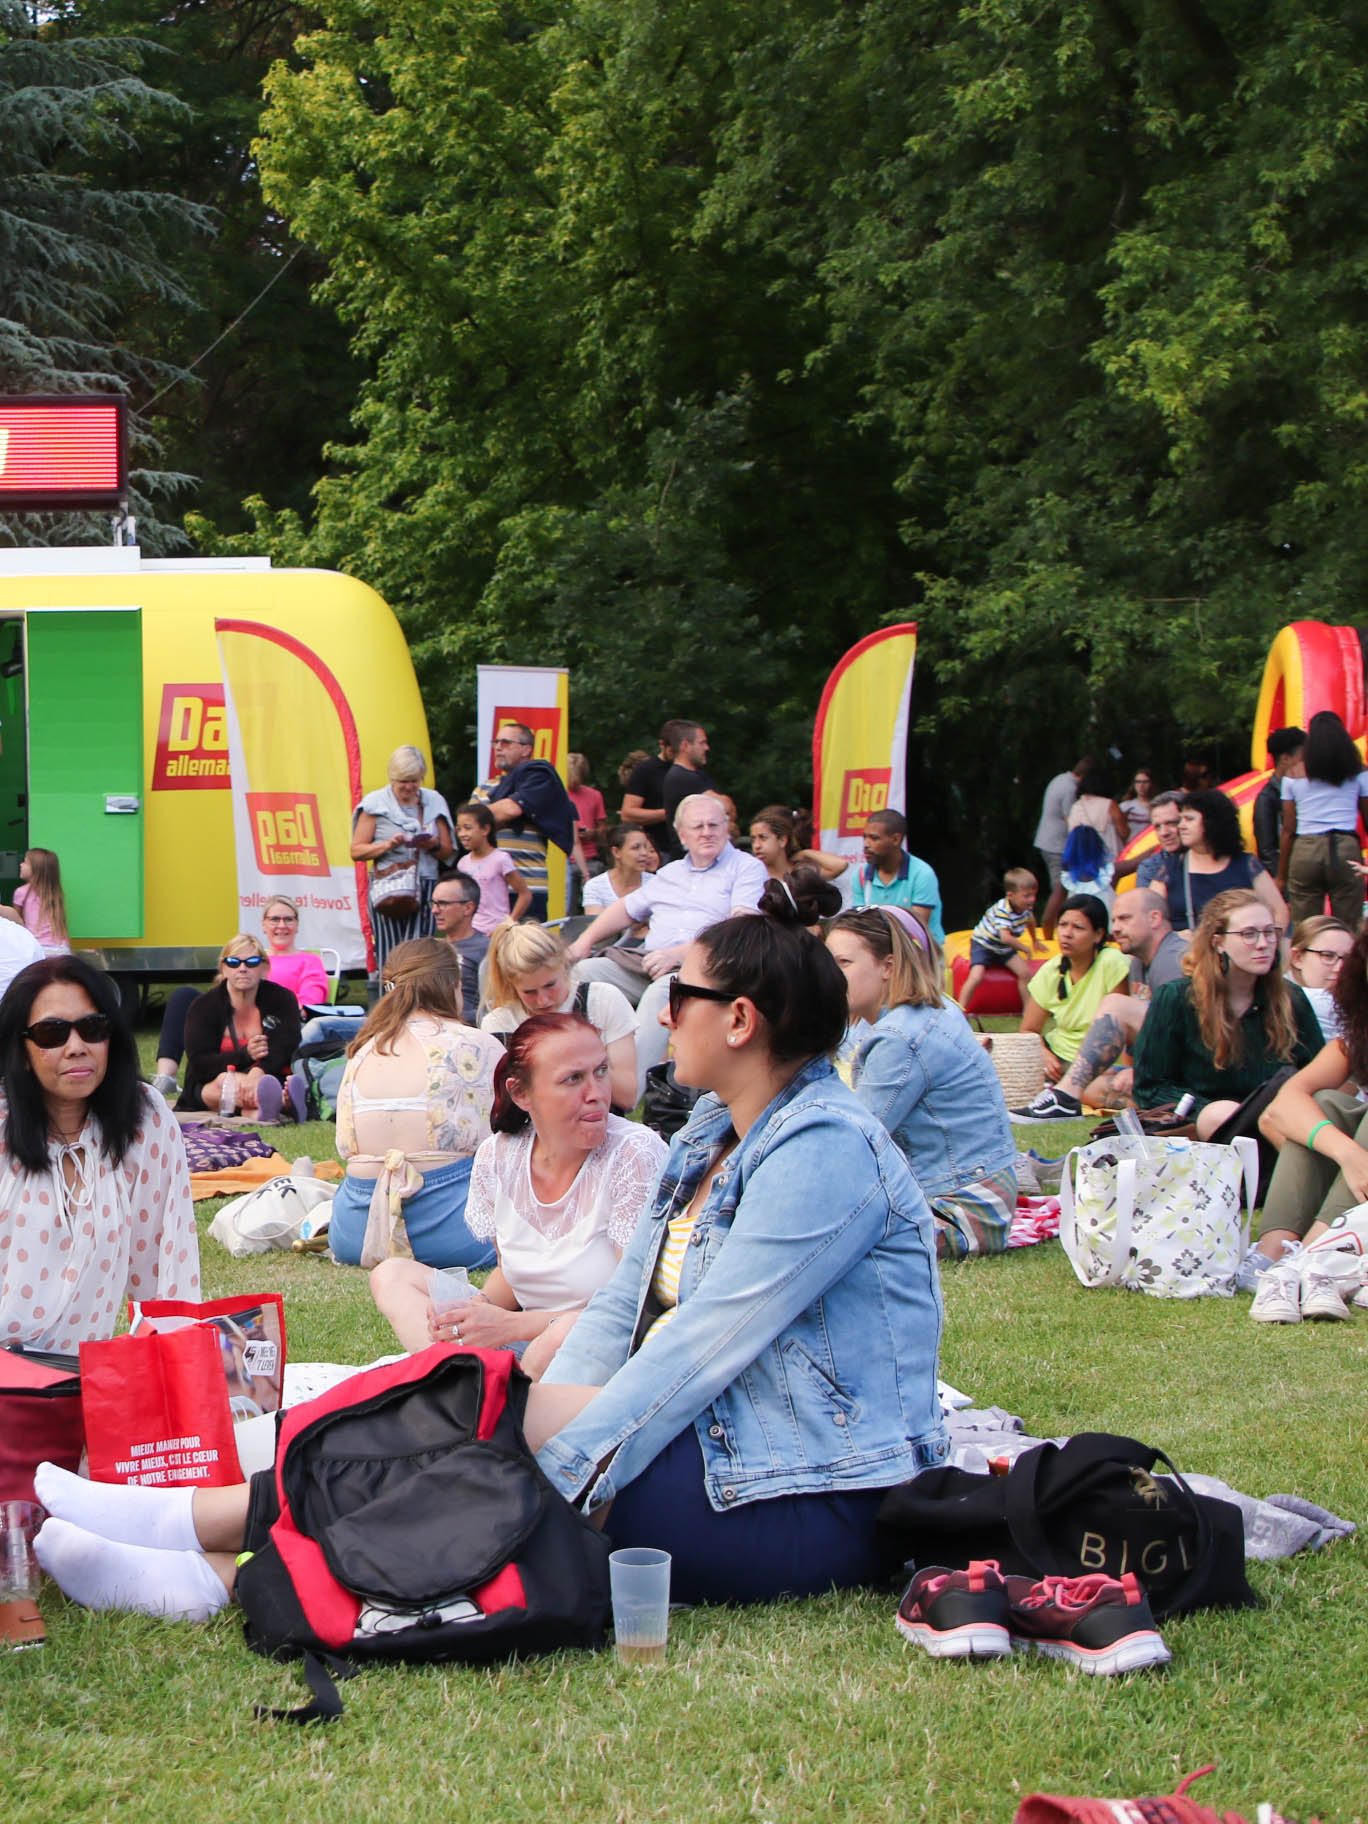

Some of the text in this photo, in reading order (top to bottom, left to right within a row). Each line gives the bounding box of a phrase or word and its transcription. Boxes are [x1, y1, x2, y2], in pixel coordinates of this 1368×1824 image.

[167, 696, 229, 752] Da
[166, 754, 231, 776] allema
[130, 1442, 155, 1457] MIEUX
[180, 1436, 200, 1450] POUR
[115, 1460, 140, 1474] VIVRE
[141, 1455, 169, 1471] MIEUX,
[182, 1451, 192, 1464] LE
[127, 1475, 139, 1486] DE
[140, 1470, 167, 1485] NOTRE
